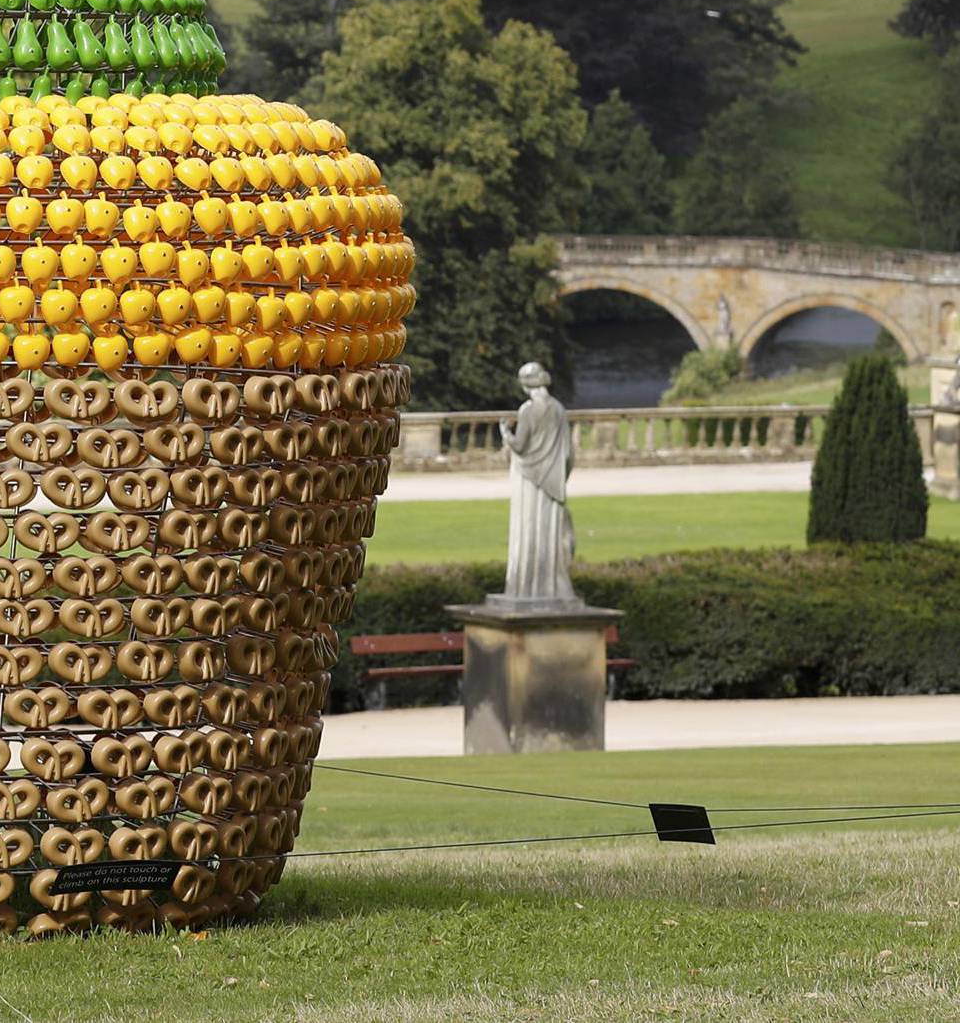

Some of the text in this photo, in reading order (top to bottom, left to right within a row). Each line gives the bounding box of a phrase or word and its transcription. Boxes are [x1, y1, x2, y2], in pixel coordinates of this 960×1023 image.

[63, 870, 92, 880] Please
[94, 868, 107, 876] do
[59, 880, 84, 889] climb
[103, 875, 120, 884] this
[122, 875, 168, 884] sculpture
